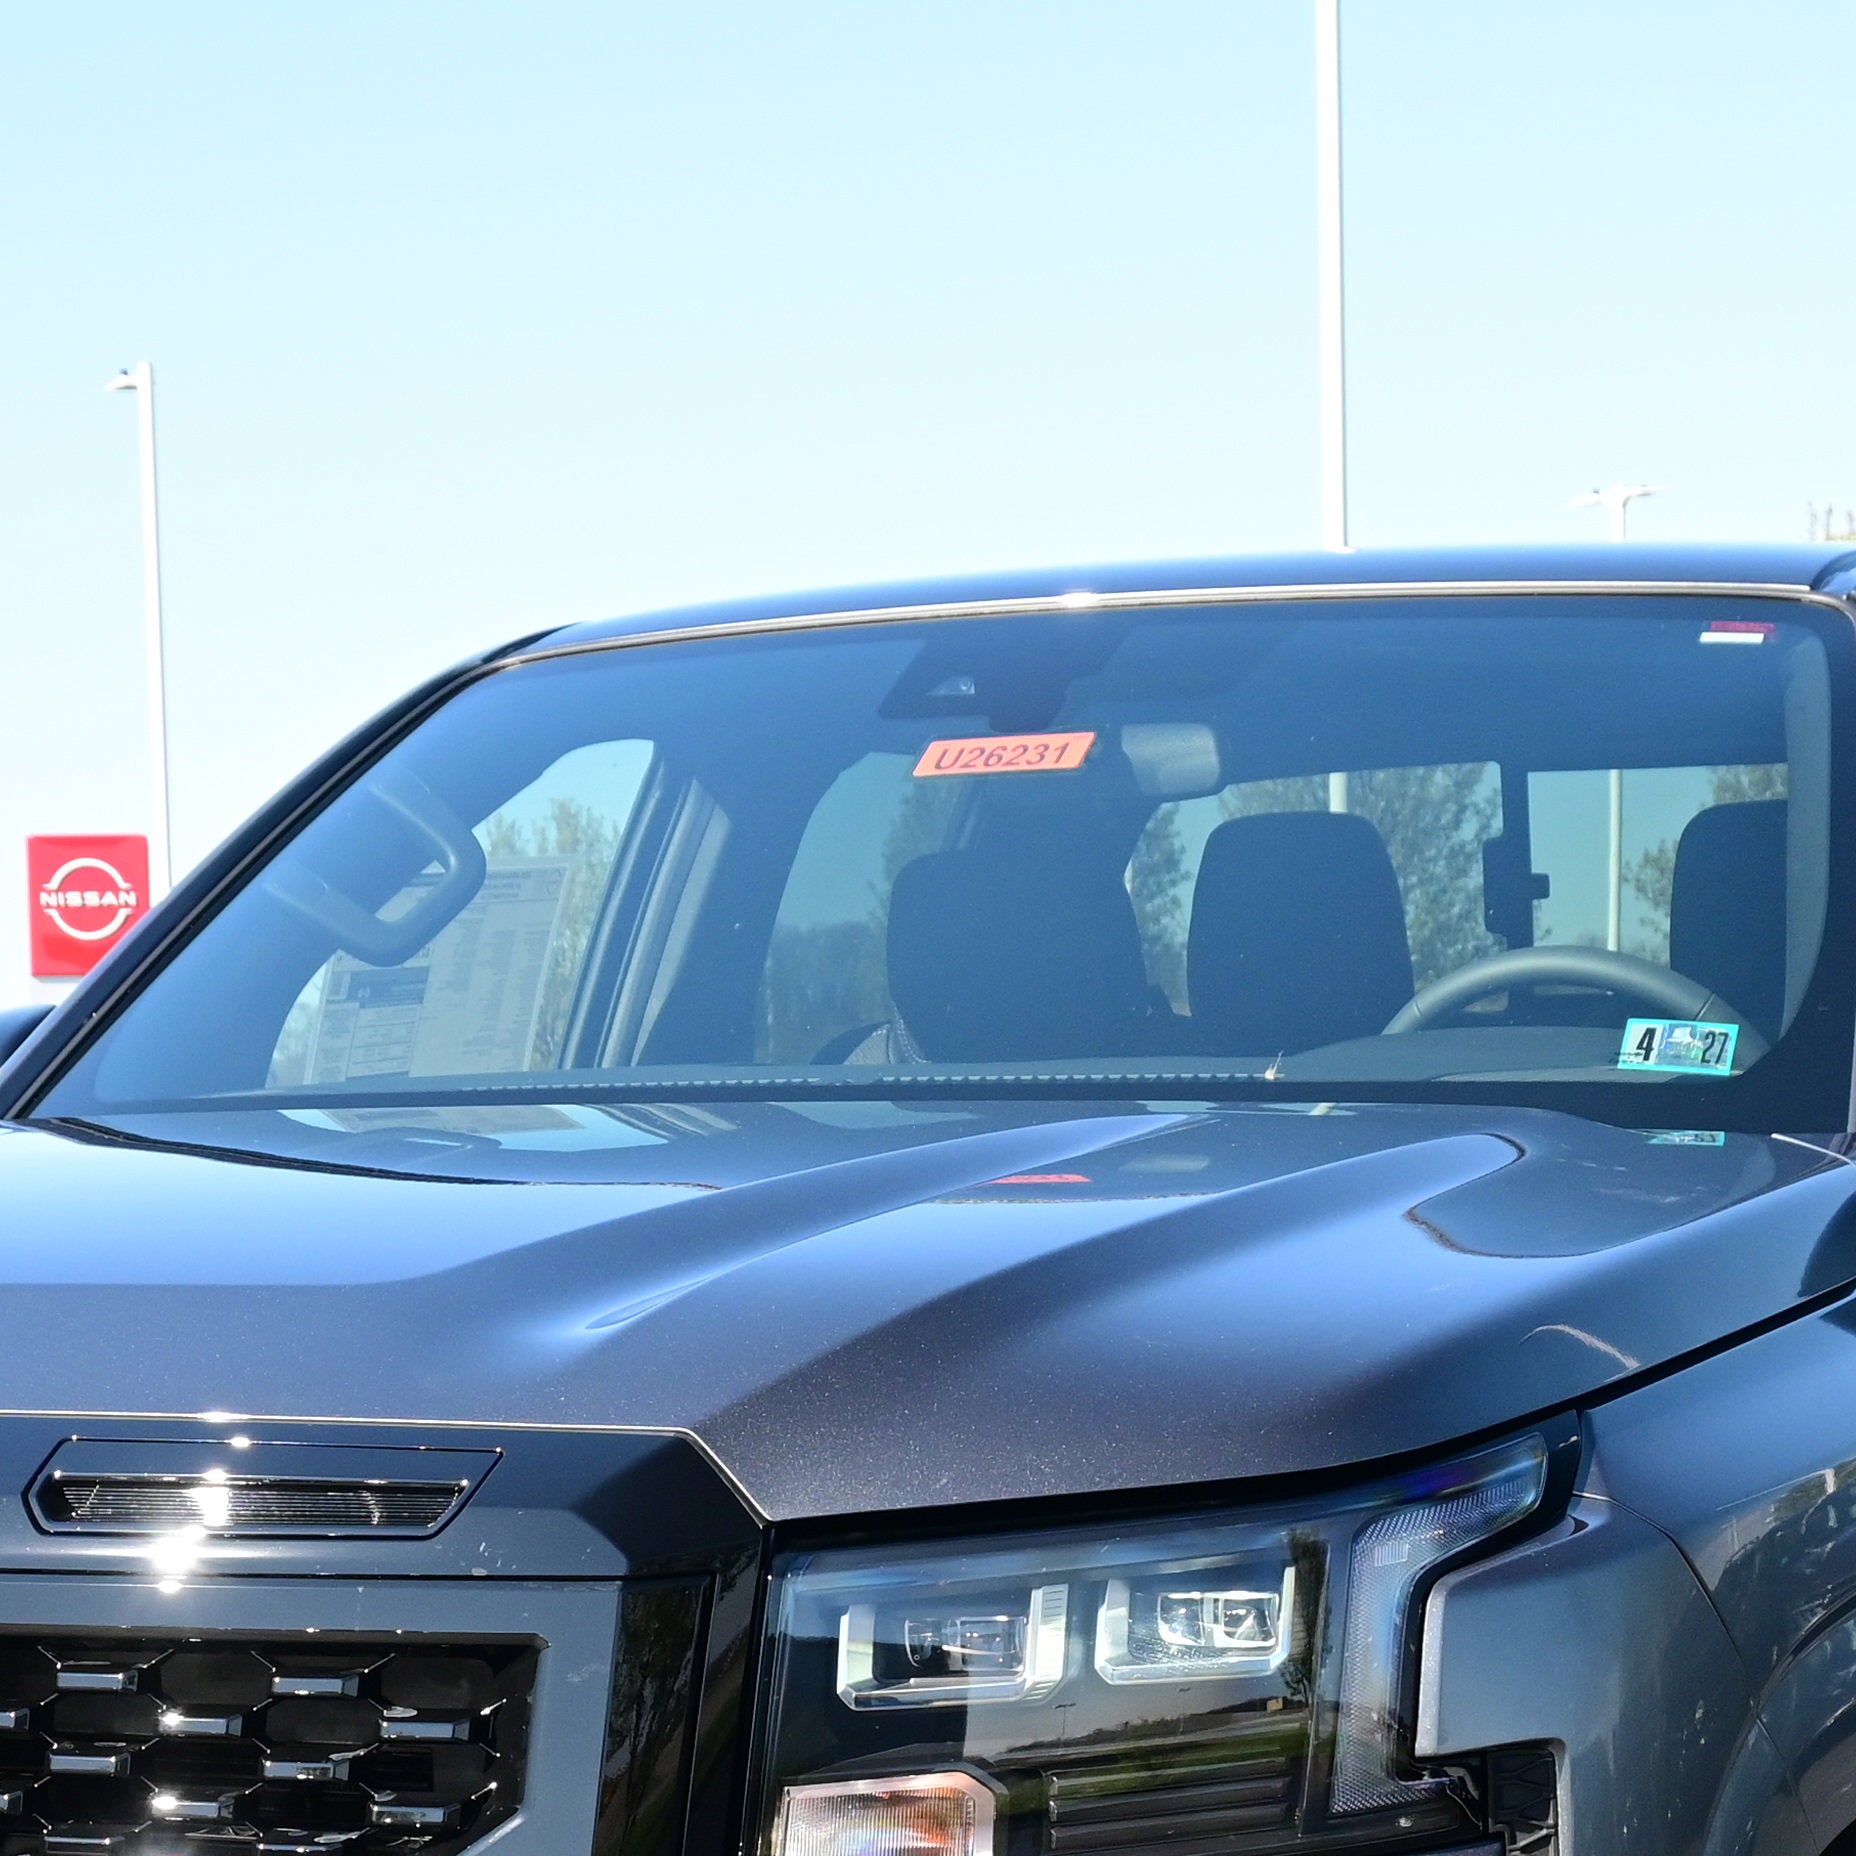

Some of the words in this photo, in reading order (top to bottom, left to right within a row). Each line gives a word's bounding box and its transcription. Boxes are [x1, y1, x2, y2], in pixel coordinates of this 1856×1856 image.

[933, 741, 1072, 771] U26231
[39, 890, 138, 908] NISSAN
[1635, 1026, 1658, 1062] 4
[1699, 1030, 1730, 1065] 27
